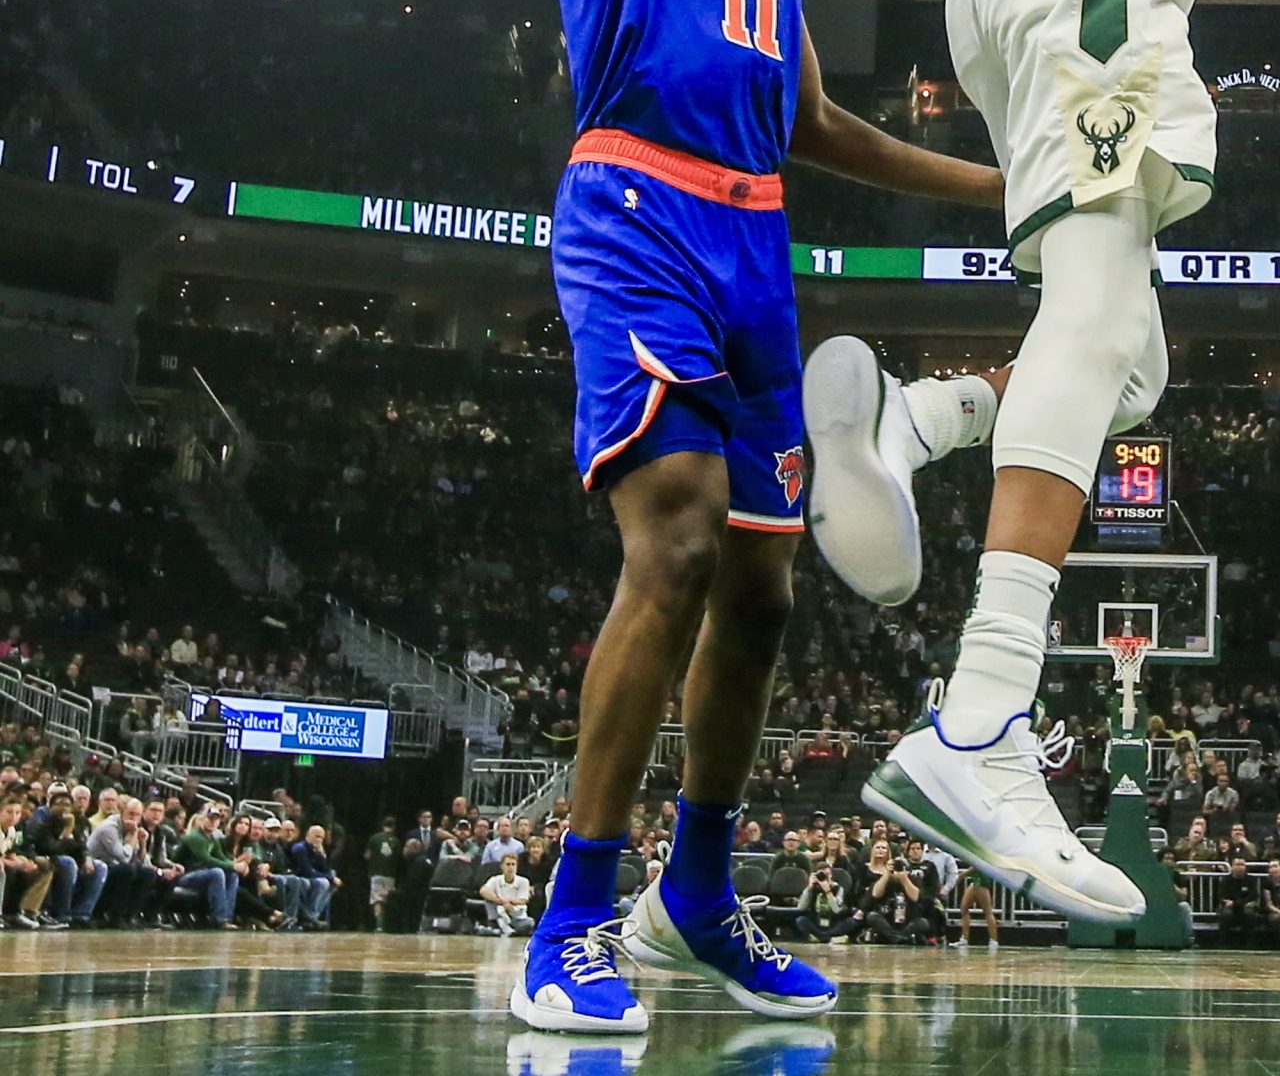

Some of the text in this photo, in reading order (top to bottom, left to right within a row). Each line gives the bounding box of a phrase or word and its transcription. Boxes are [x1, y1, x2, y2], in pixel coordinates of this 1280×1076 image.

[1216, 72, 1242, 92] JACK
[86, 159, 195, 204] TOL 7
[361, 196, 528, 246] MILWAUKEE
[812, 249, 843, 274] 11
[962, 252, 1015, 278] 9:4
[1181, 255, 1252, 280] QTR
[1114, 443, 1162, 466] 9:40
[1120, 466, 1155, 503] 19
[1114, 507, 1166, 519] TISSOT
[298, 721, 350, 738] COLLEGE
[307, 710, 358, 728] MEDICAL
[298, 731, 361, 748] WISCONSIN
